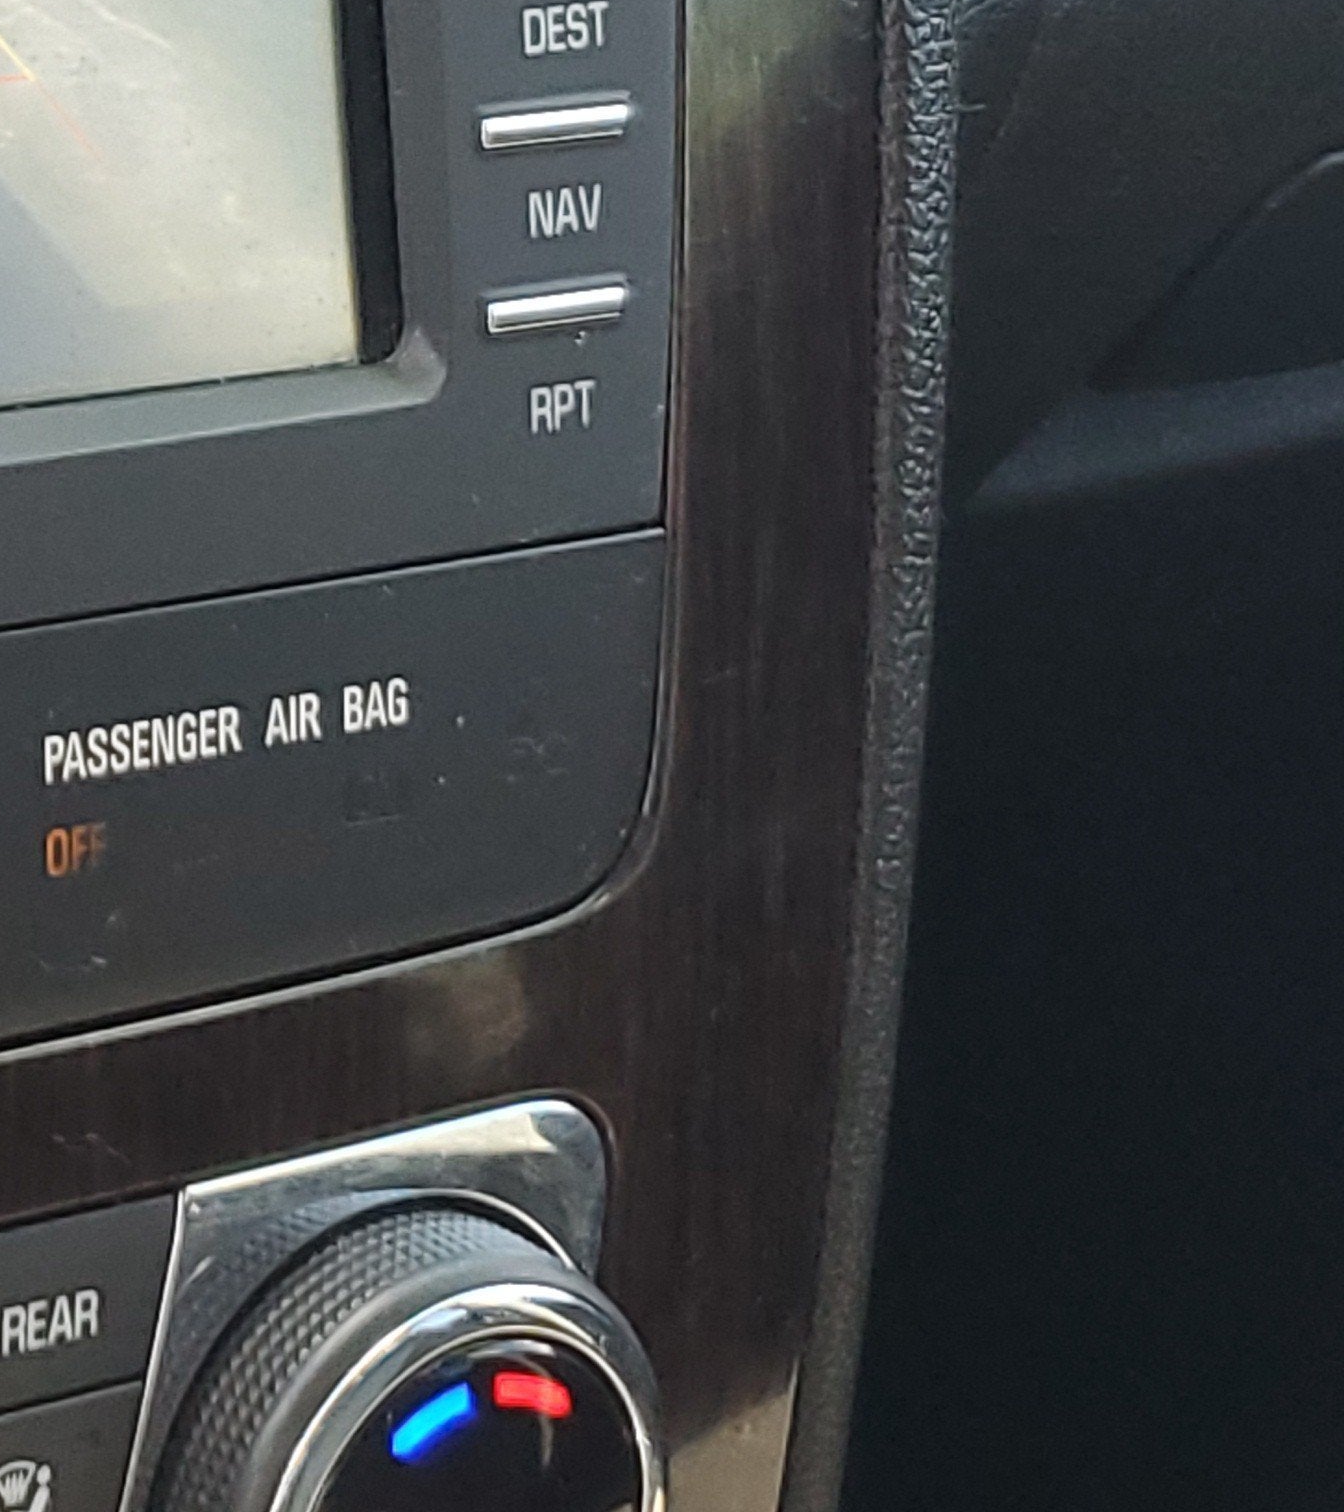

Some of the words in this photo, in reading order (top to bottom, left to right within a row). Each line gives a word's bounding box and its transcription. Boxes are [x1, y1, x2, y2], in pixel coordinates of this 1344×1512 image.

[522, 1, 609, 57] DEST
[528, 183, 602, 238] NAV
[530, 379, 596, 434] RPT
[43, 706, 243, 785] PASSENGER
[264, 692, 323, 747] AIR
[343, 677, 409, 734] BAG
[45, 822, 107, 877] OFF
[1, 1289, 99, 1357] REAR
